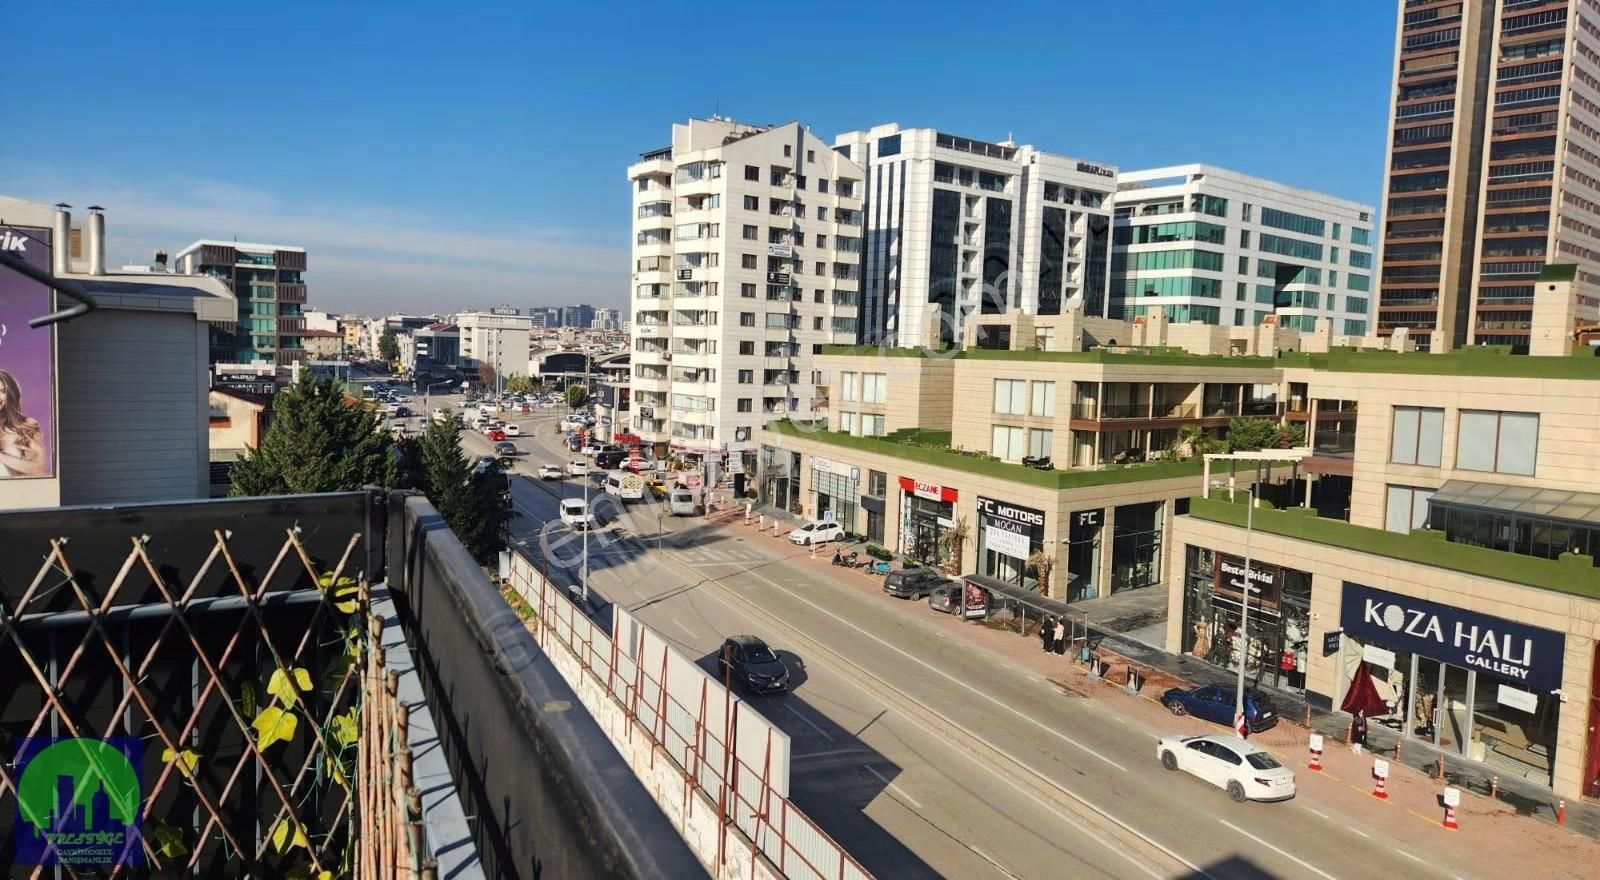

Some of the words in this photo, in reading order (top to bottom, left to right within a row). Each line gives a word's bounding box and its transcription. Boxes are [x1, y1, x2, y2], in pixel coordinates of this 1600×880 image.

[977, 498, 994, 513] FC
[997, 505, 1044, 526] MOTORS
[1080, 512, 1098, 526] FC
[1248, 569, 1274, 584] Bridal
[1364, 599, 1444, 643] KOZA
[1454, 621, 1533, 667] HALI
[1465, 654, 1529, 680] GALLERY
